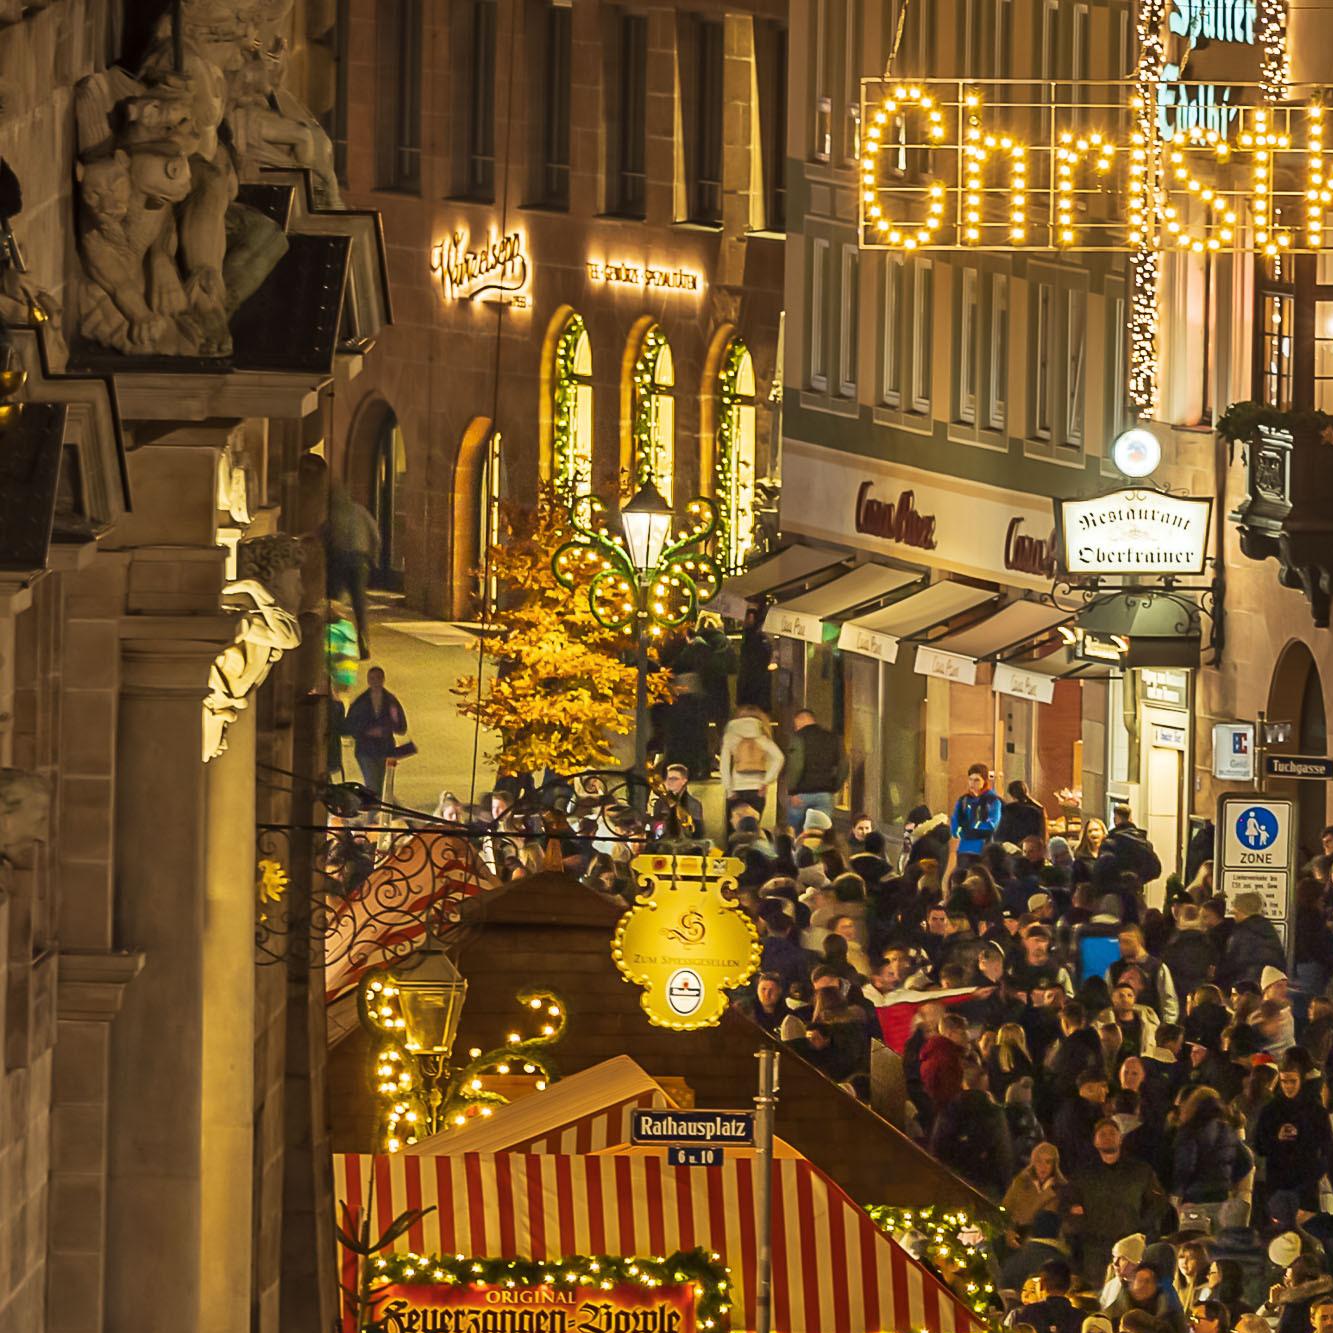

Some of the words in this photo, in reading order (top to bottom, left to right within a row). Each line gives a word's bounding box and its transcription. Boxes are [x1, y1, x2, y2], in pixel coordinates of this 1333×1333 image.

[1078, 508, 1193, 531] Restaurant
[1272, 758, 1326, 776] Tuchgasse
[1240, 853, 1272, 864] ZONE
[641, 1116, 746, 1140] Rathausplatz
[678, 1150, 686, 1164] 6
[701, 1150, 714, 1164] 10
[485, 1290, 577, 1305] ORIGINAL
